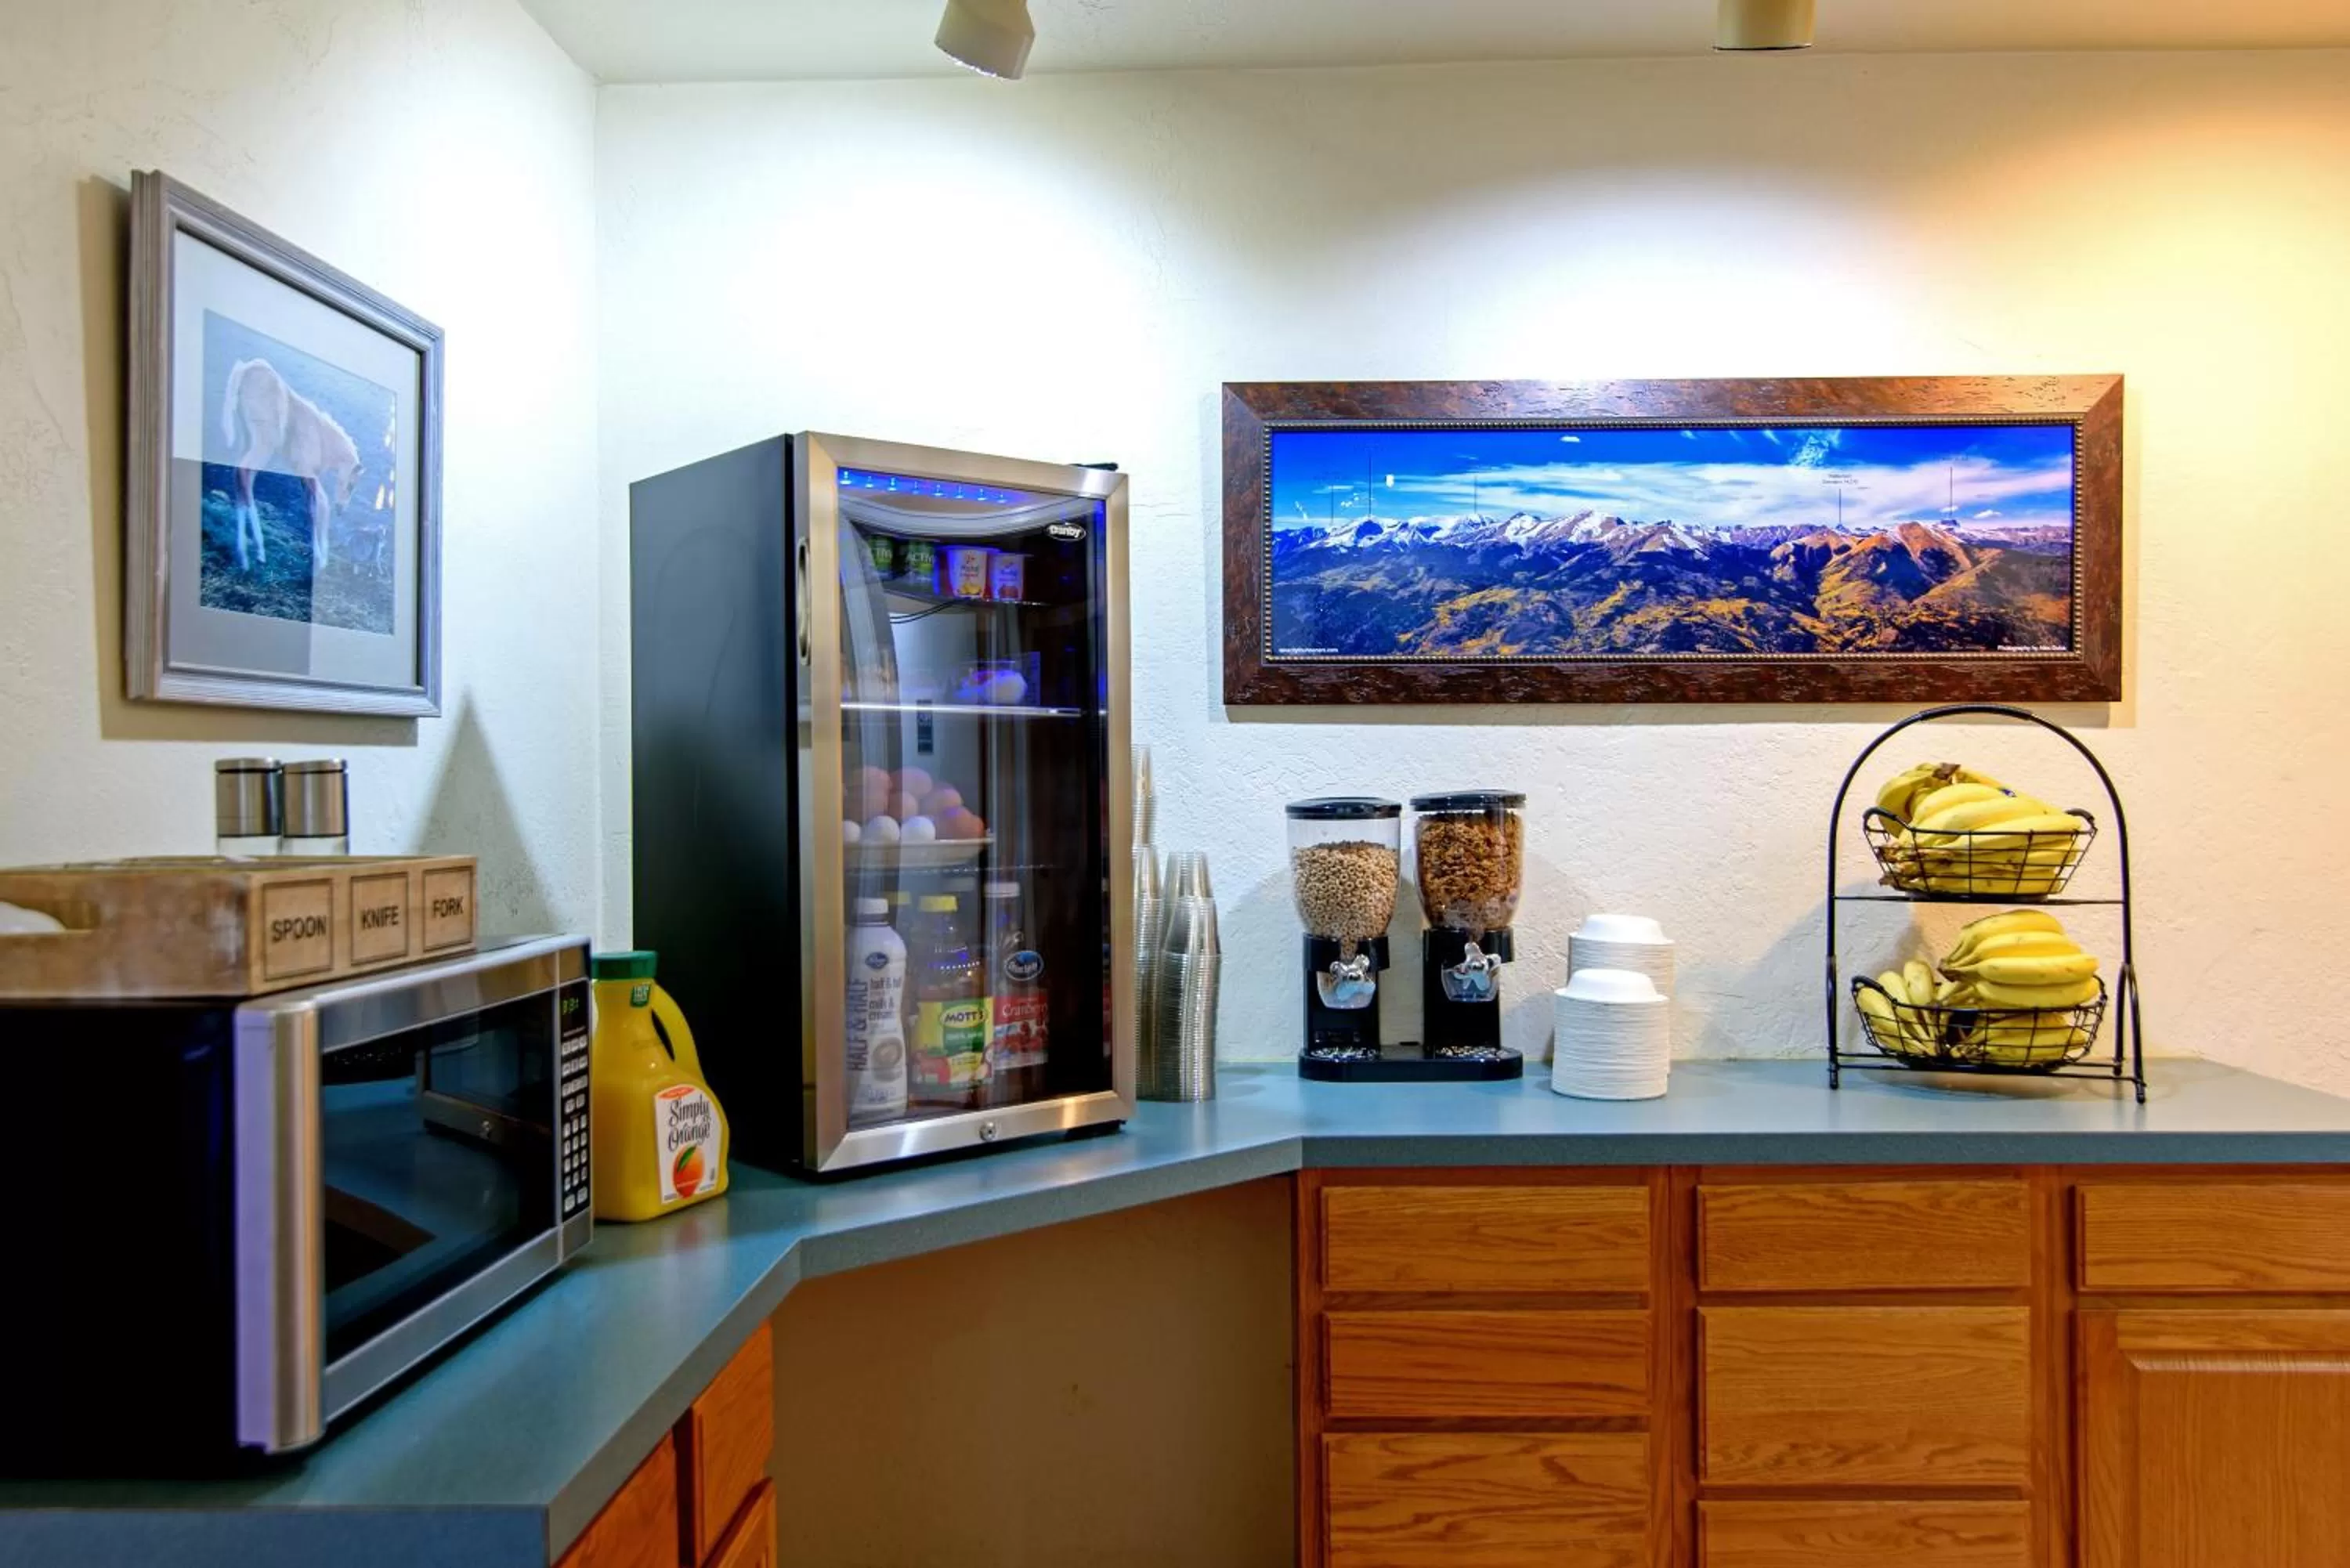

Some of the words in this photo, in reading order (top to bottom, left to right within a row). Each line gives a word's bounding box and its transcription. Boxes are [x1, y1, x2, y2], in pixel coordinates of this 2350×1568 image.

[361, 905, 400, 930] KNIFE
[432, 896, 465, 919] FORK
[271, 916, 327, 944] SPOON
[669, 1093, 711, 1127] Simply
[667, 1123, 710, 1152] Orange
